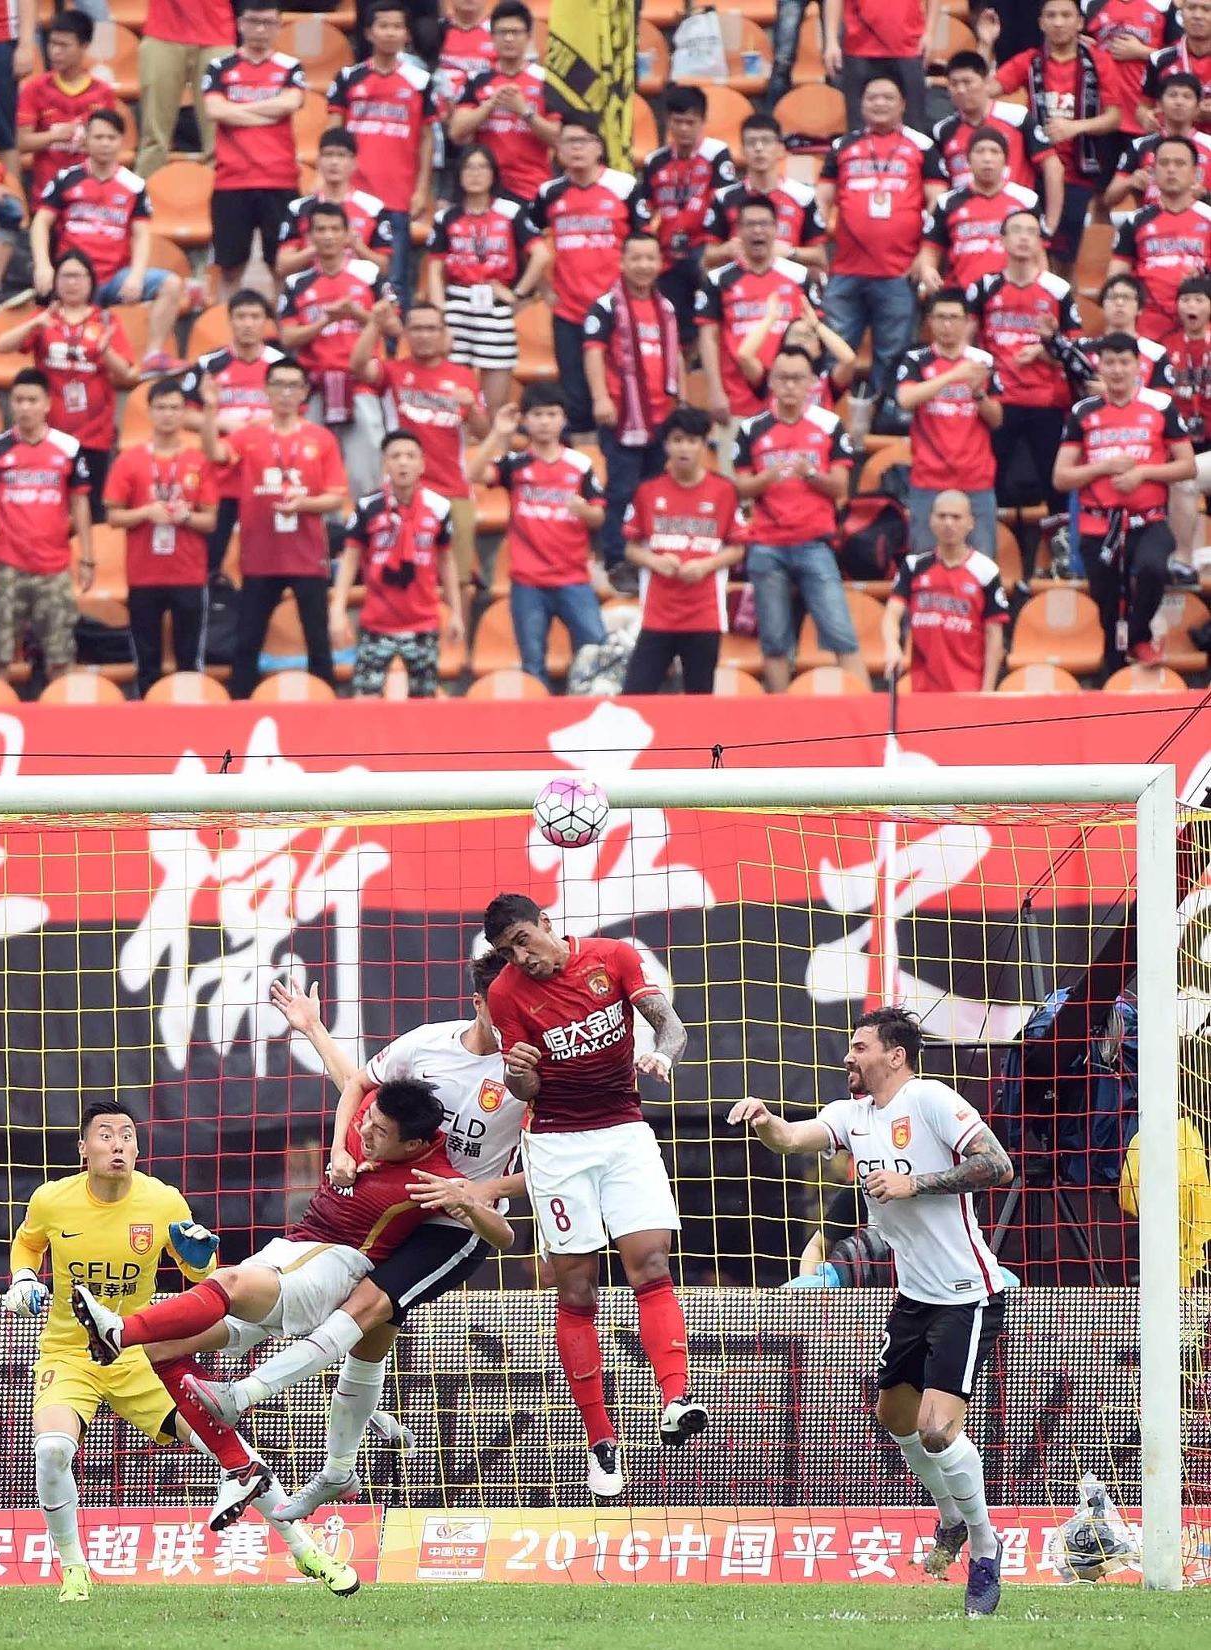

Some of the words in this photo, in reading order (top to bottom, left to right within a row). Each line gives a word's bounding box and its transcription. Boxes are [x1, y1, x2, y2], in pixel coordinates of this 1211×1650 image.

[543, 1000, 625, 1052] 恒大金服
[440, 1109, 487, 1139] FLD
[446, 1135, 482, 1158] 幸福
[550, 1197, 571, 1232] 8
[68, 1261, 140, 1281] CFLD
[39, 1369, 56, 1392] 9
[427, 1546, 478, 1557] 中国平安
